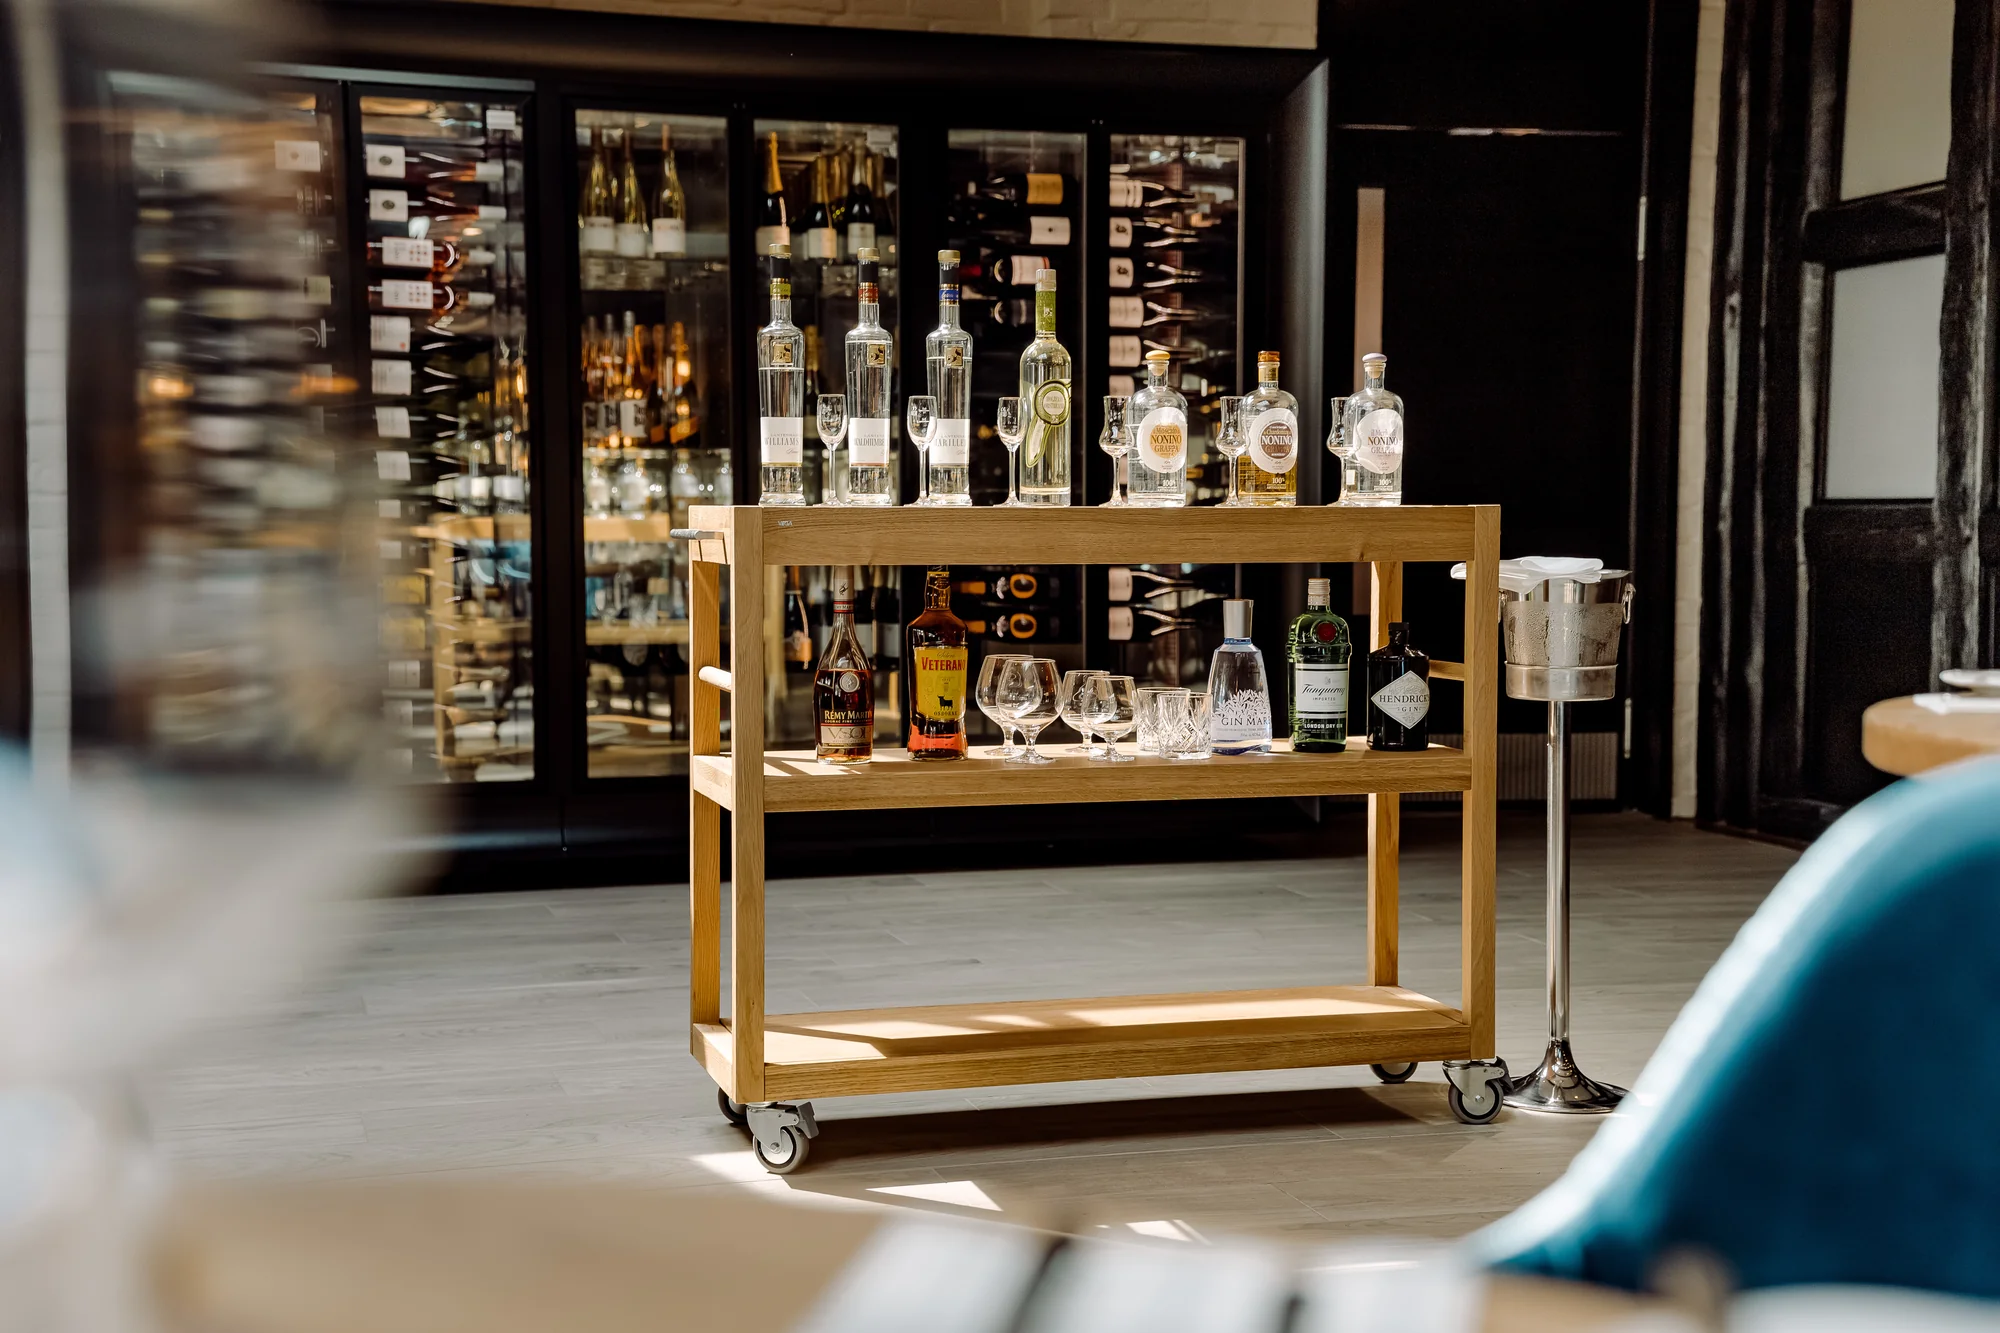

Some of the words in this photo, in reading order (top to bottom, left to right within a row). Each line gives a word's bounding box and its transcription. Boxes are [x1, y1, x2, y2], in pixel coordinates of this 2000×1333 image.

[764, 437, 800, 446] WILLIAMS
[1151, 434, 1182, 445] NONINO
[1261, 435, 1292, 446] NONINO
[1367, 436, 1399, 446] NONINO
[1154, 444, 1180, 453] GRAPPA
[1302, 683, 1346, 696] Tanqueray
[824, 710, 846, 720] RÉMY
[1221, 717, 1243, 726] GIN
